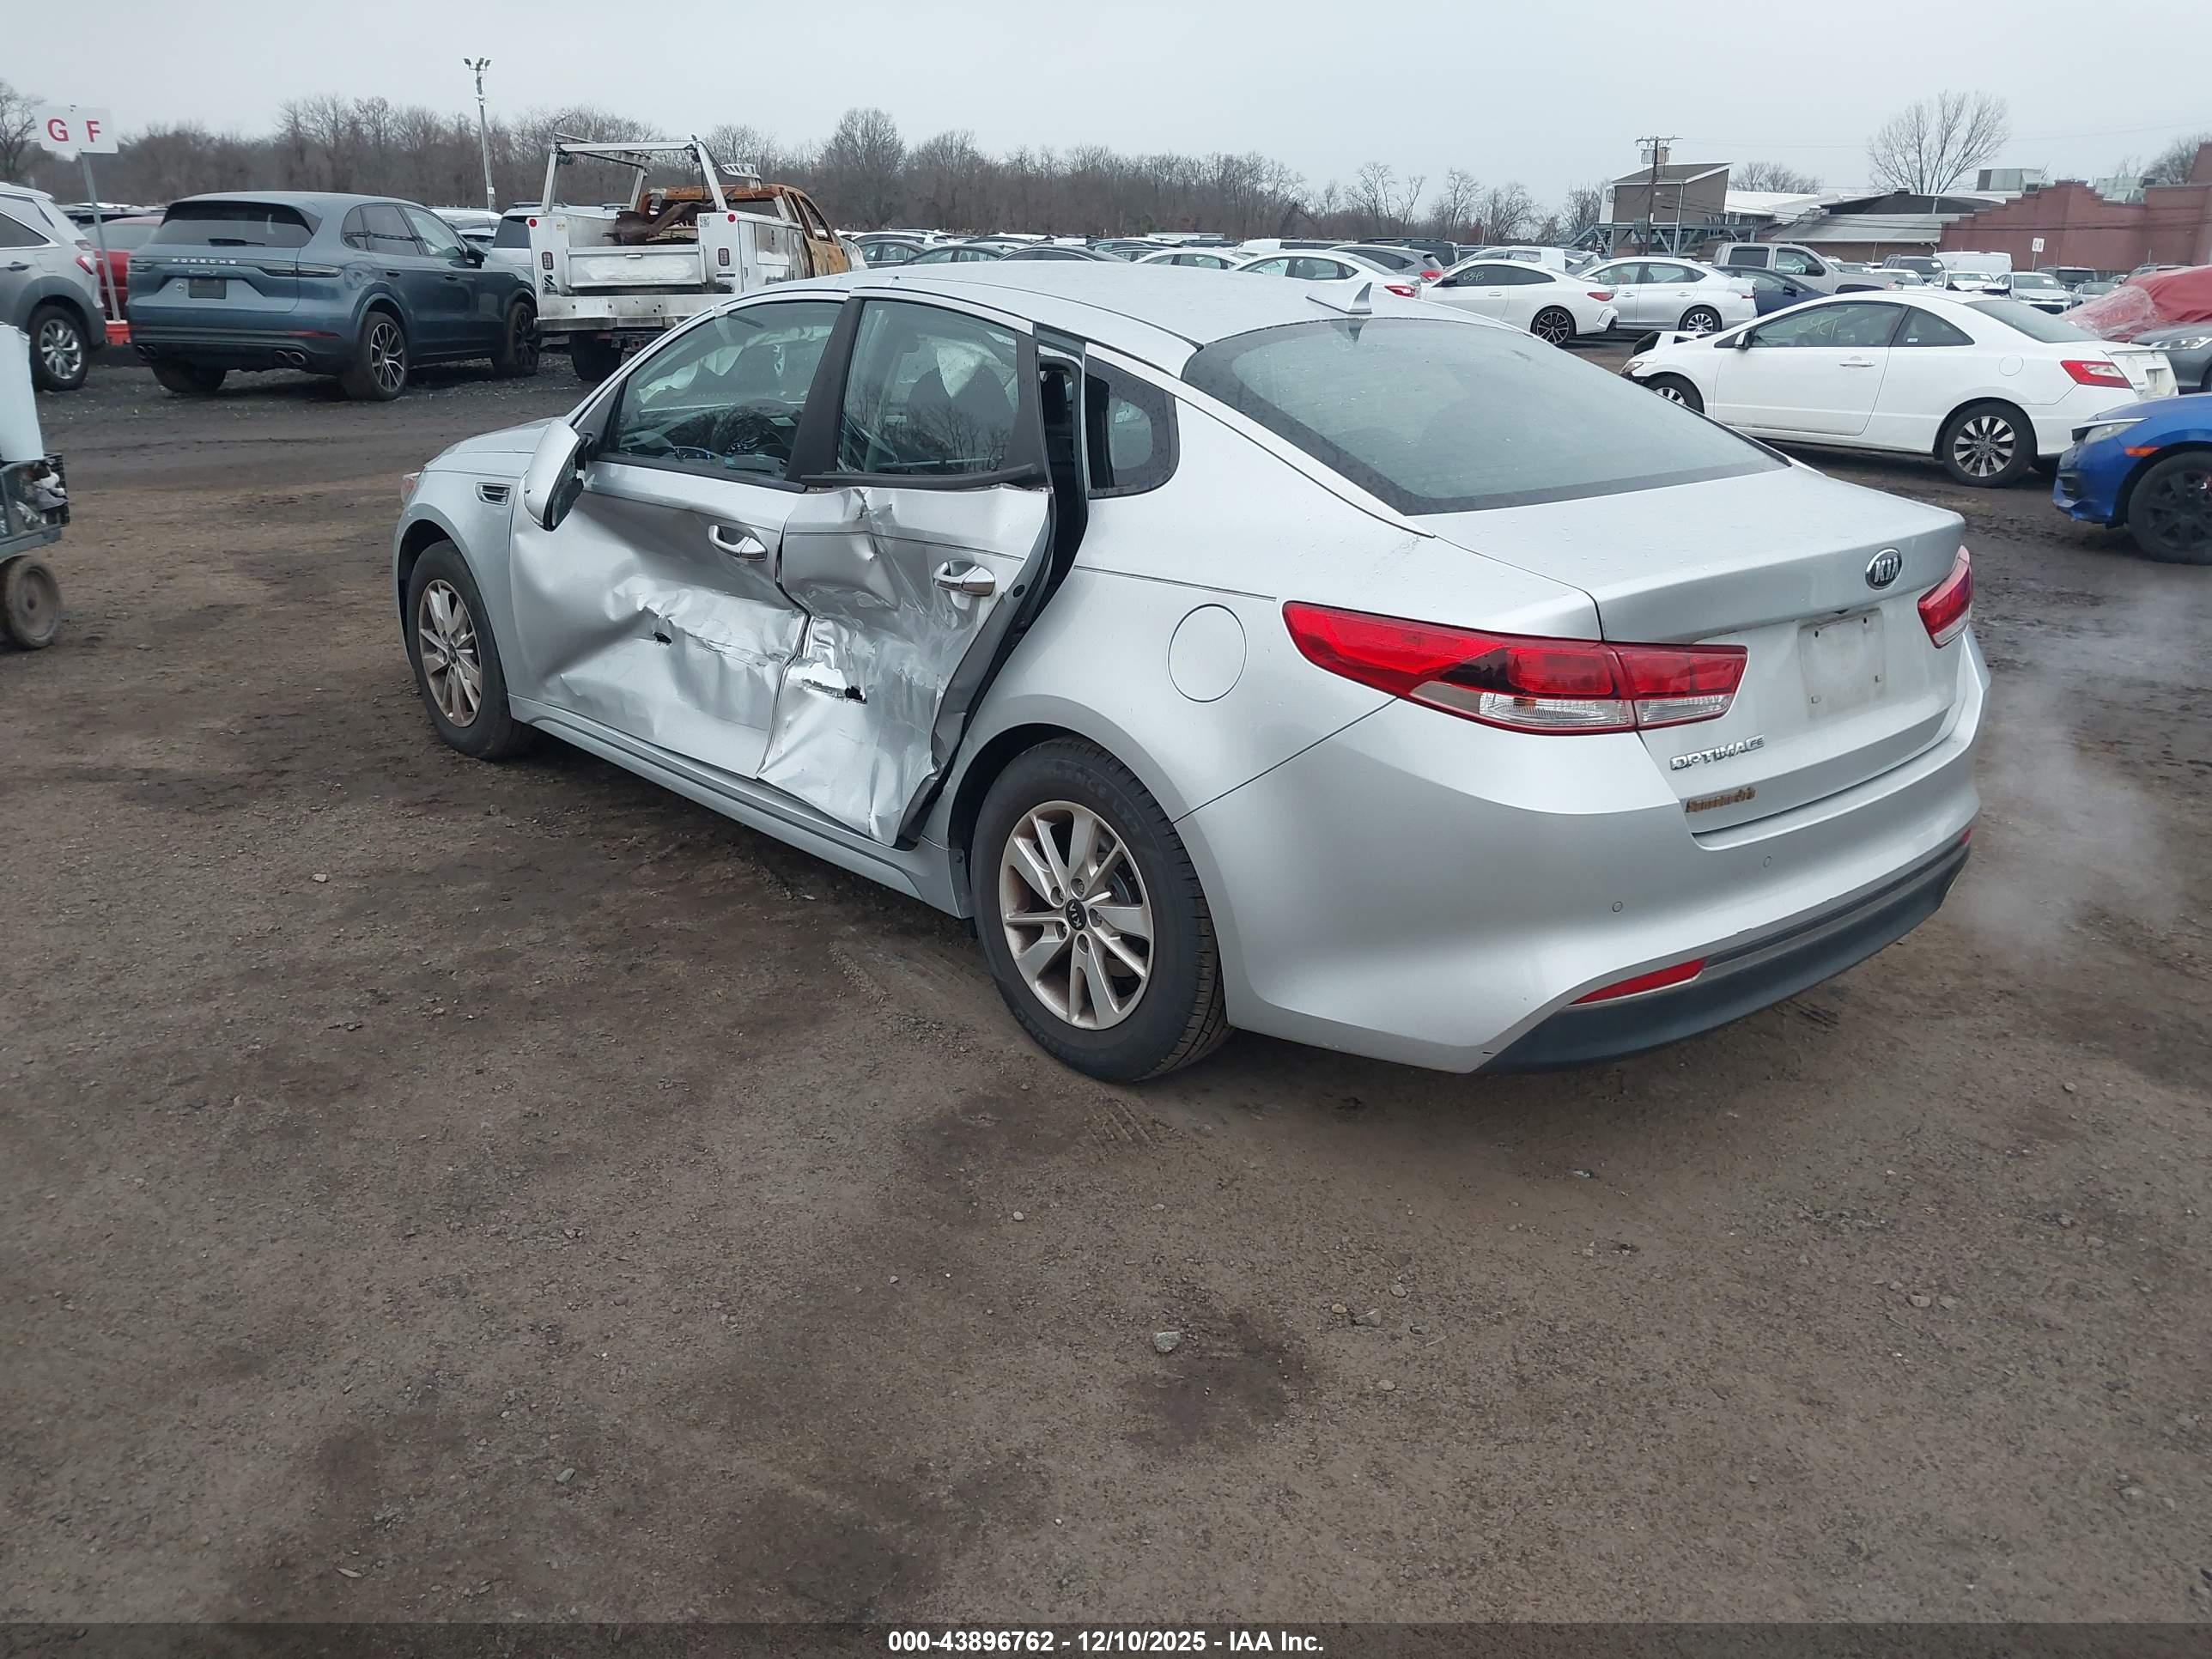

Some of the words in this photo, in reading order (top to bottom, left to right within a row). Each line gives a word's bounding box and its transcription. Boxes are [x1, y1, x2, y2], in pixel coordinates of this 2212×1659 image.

[47, 118, 69, 143] G
[86, 120, 101, 143] F
[1874, 556, 1899, 583] KIA
[1669, 741, 1746, 771] OPTIMA
[1069, 902, 1082, 927] KIA
